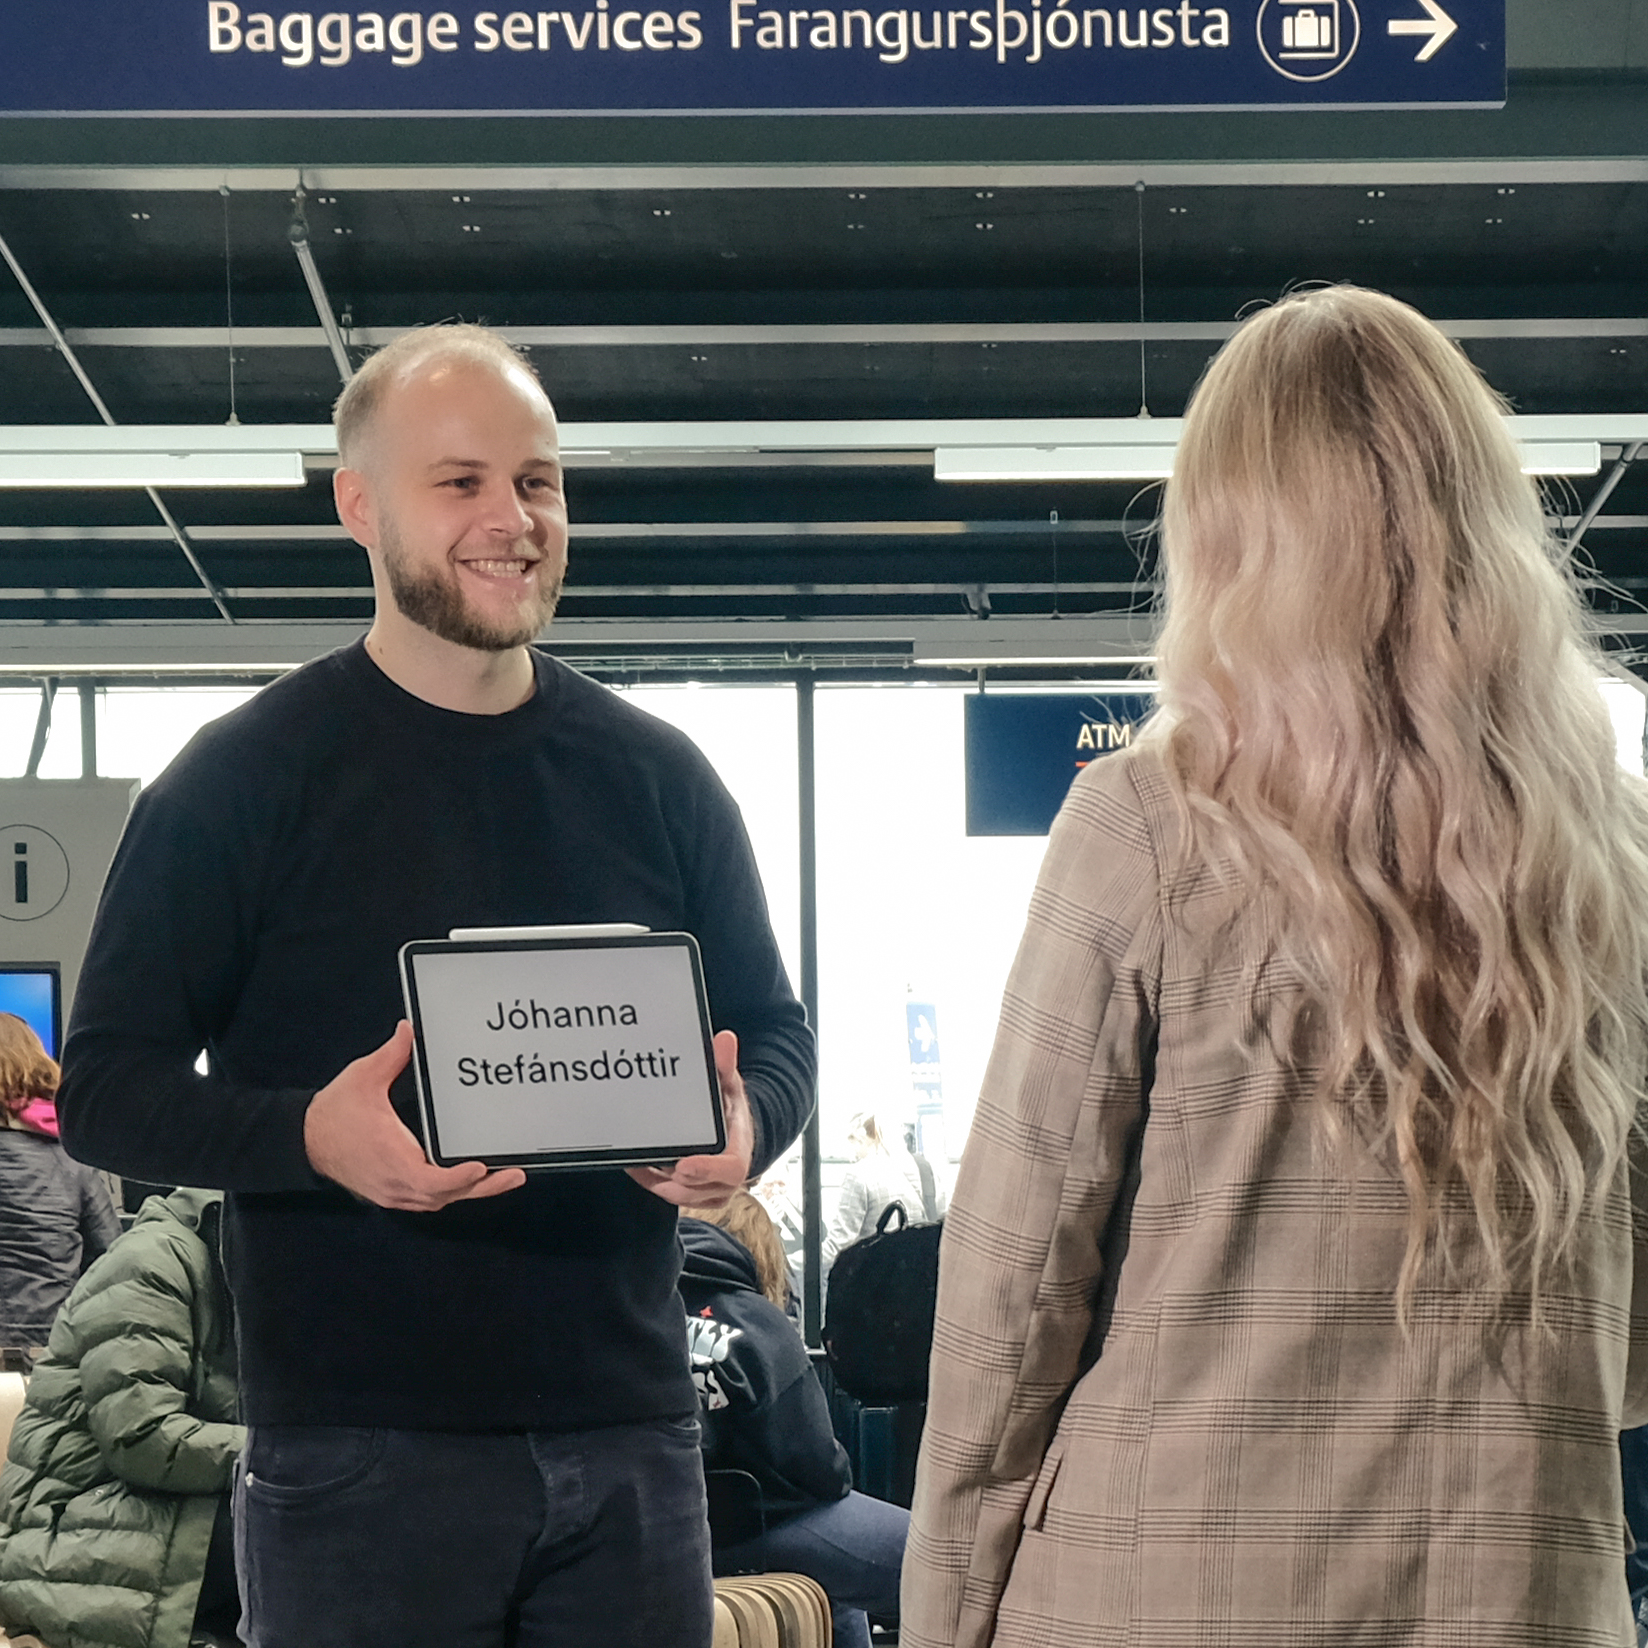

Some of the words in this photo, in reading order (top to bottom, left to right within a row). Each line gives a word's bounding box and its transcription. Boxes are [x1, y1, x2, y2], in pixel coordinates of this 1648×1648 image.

[208, 0, 459, 67] Baggage
[474, 0, 702, 51] services
[730, 0, 1231, 63] Farangursþjónusta
[1076, 723, 1130, 750] ATM
[486, 999, 639, 1031] Jóhanna
[457, 1047, 681, 1087] Stefánsdóttir
